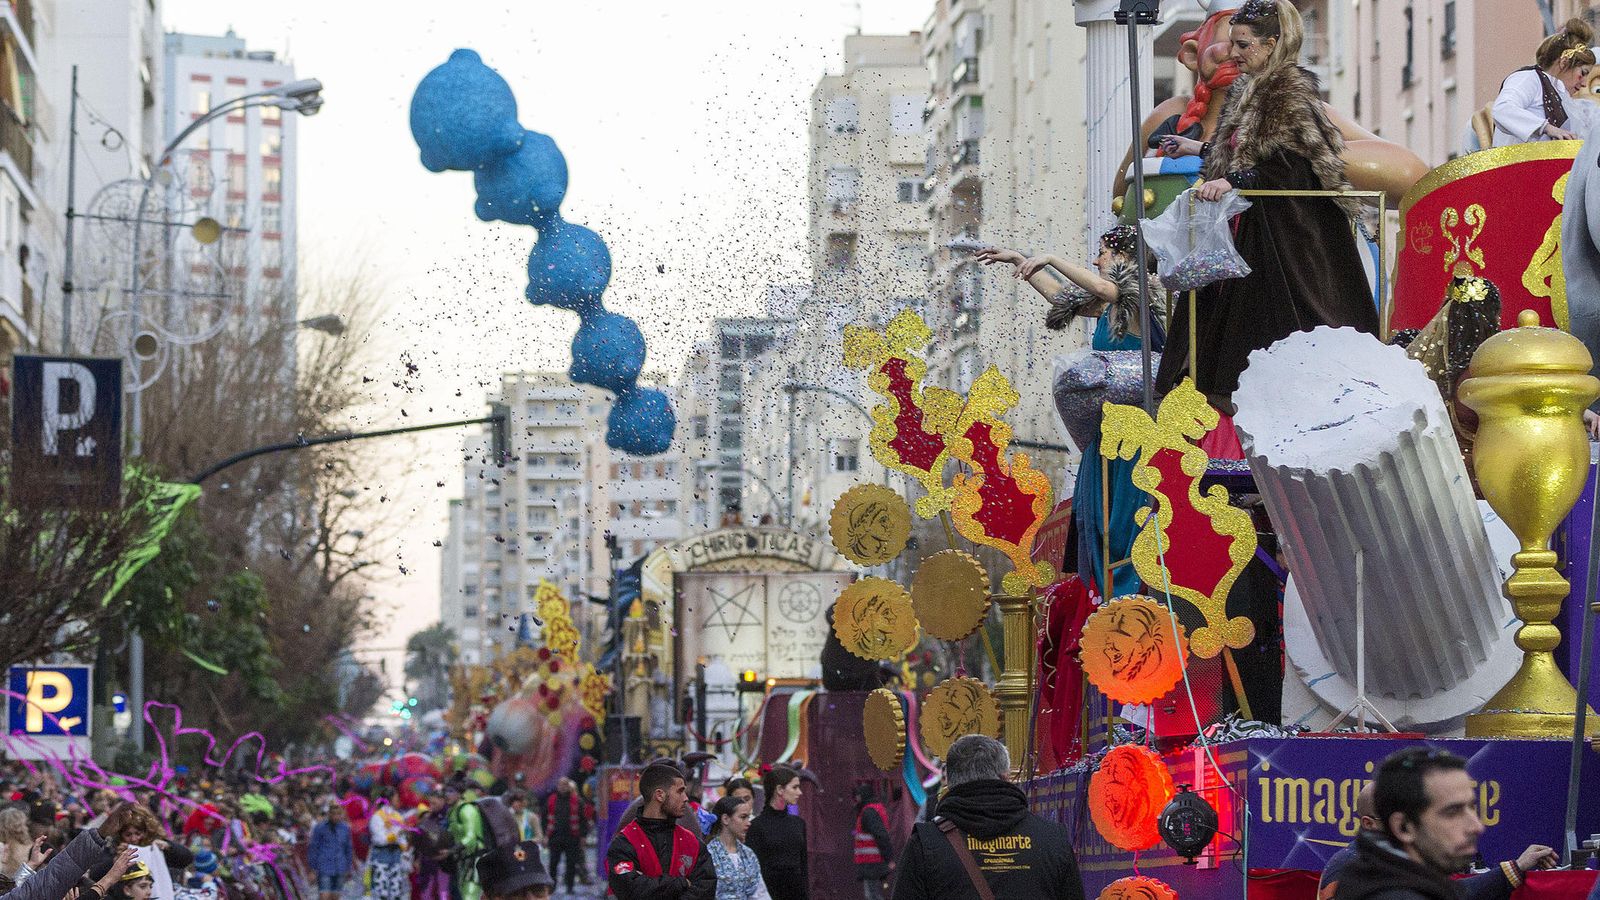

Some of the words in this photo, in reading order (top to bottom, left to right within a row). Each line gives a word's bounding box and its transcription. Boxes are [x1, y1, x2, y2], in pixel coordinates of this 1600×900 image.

[42, 361, 97, 456] P
[691, 532, 814, 559] CHIRIGTICAS
[26, 671, 73, 733] P
[1258, 761, 1500, 836] image
[967, 834, 1032, 853] imaginarte
